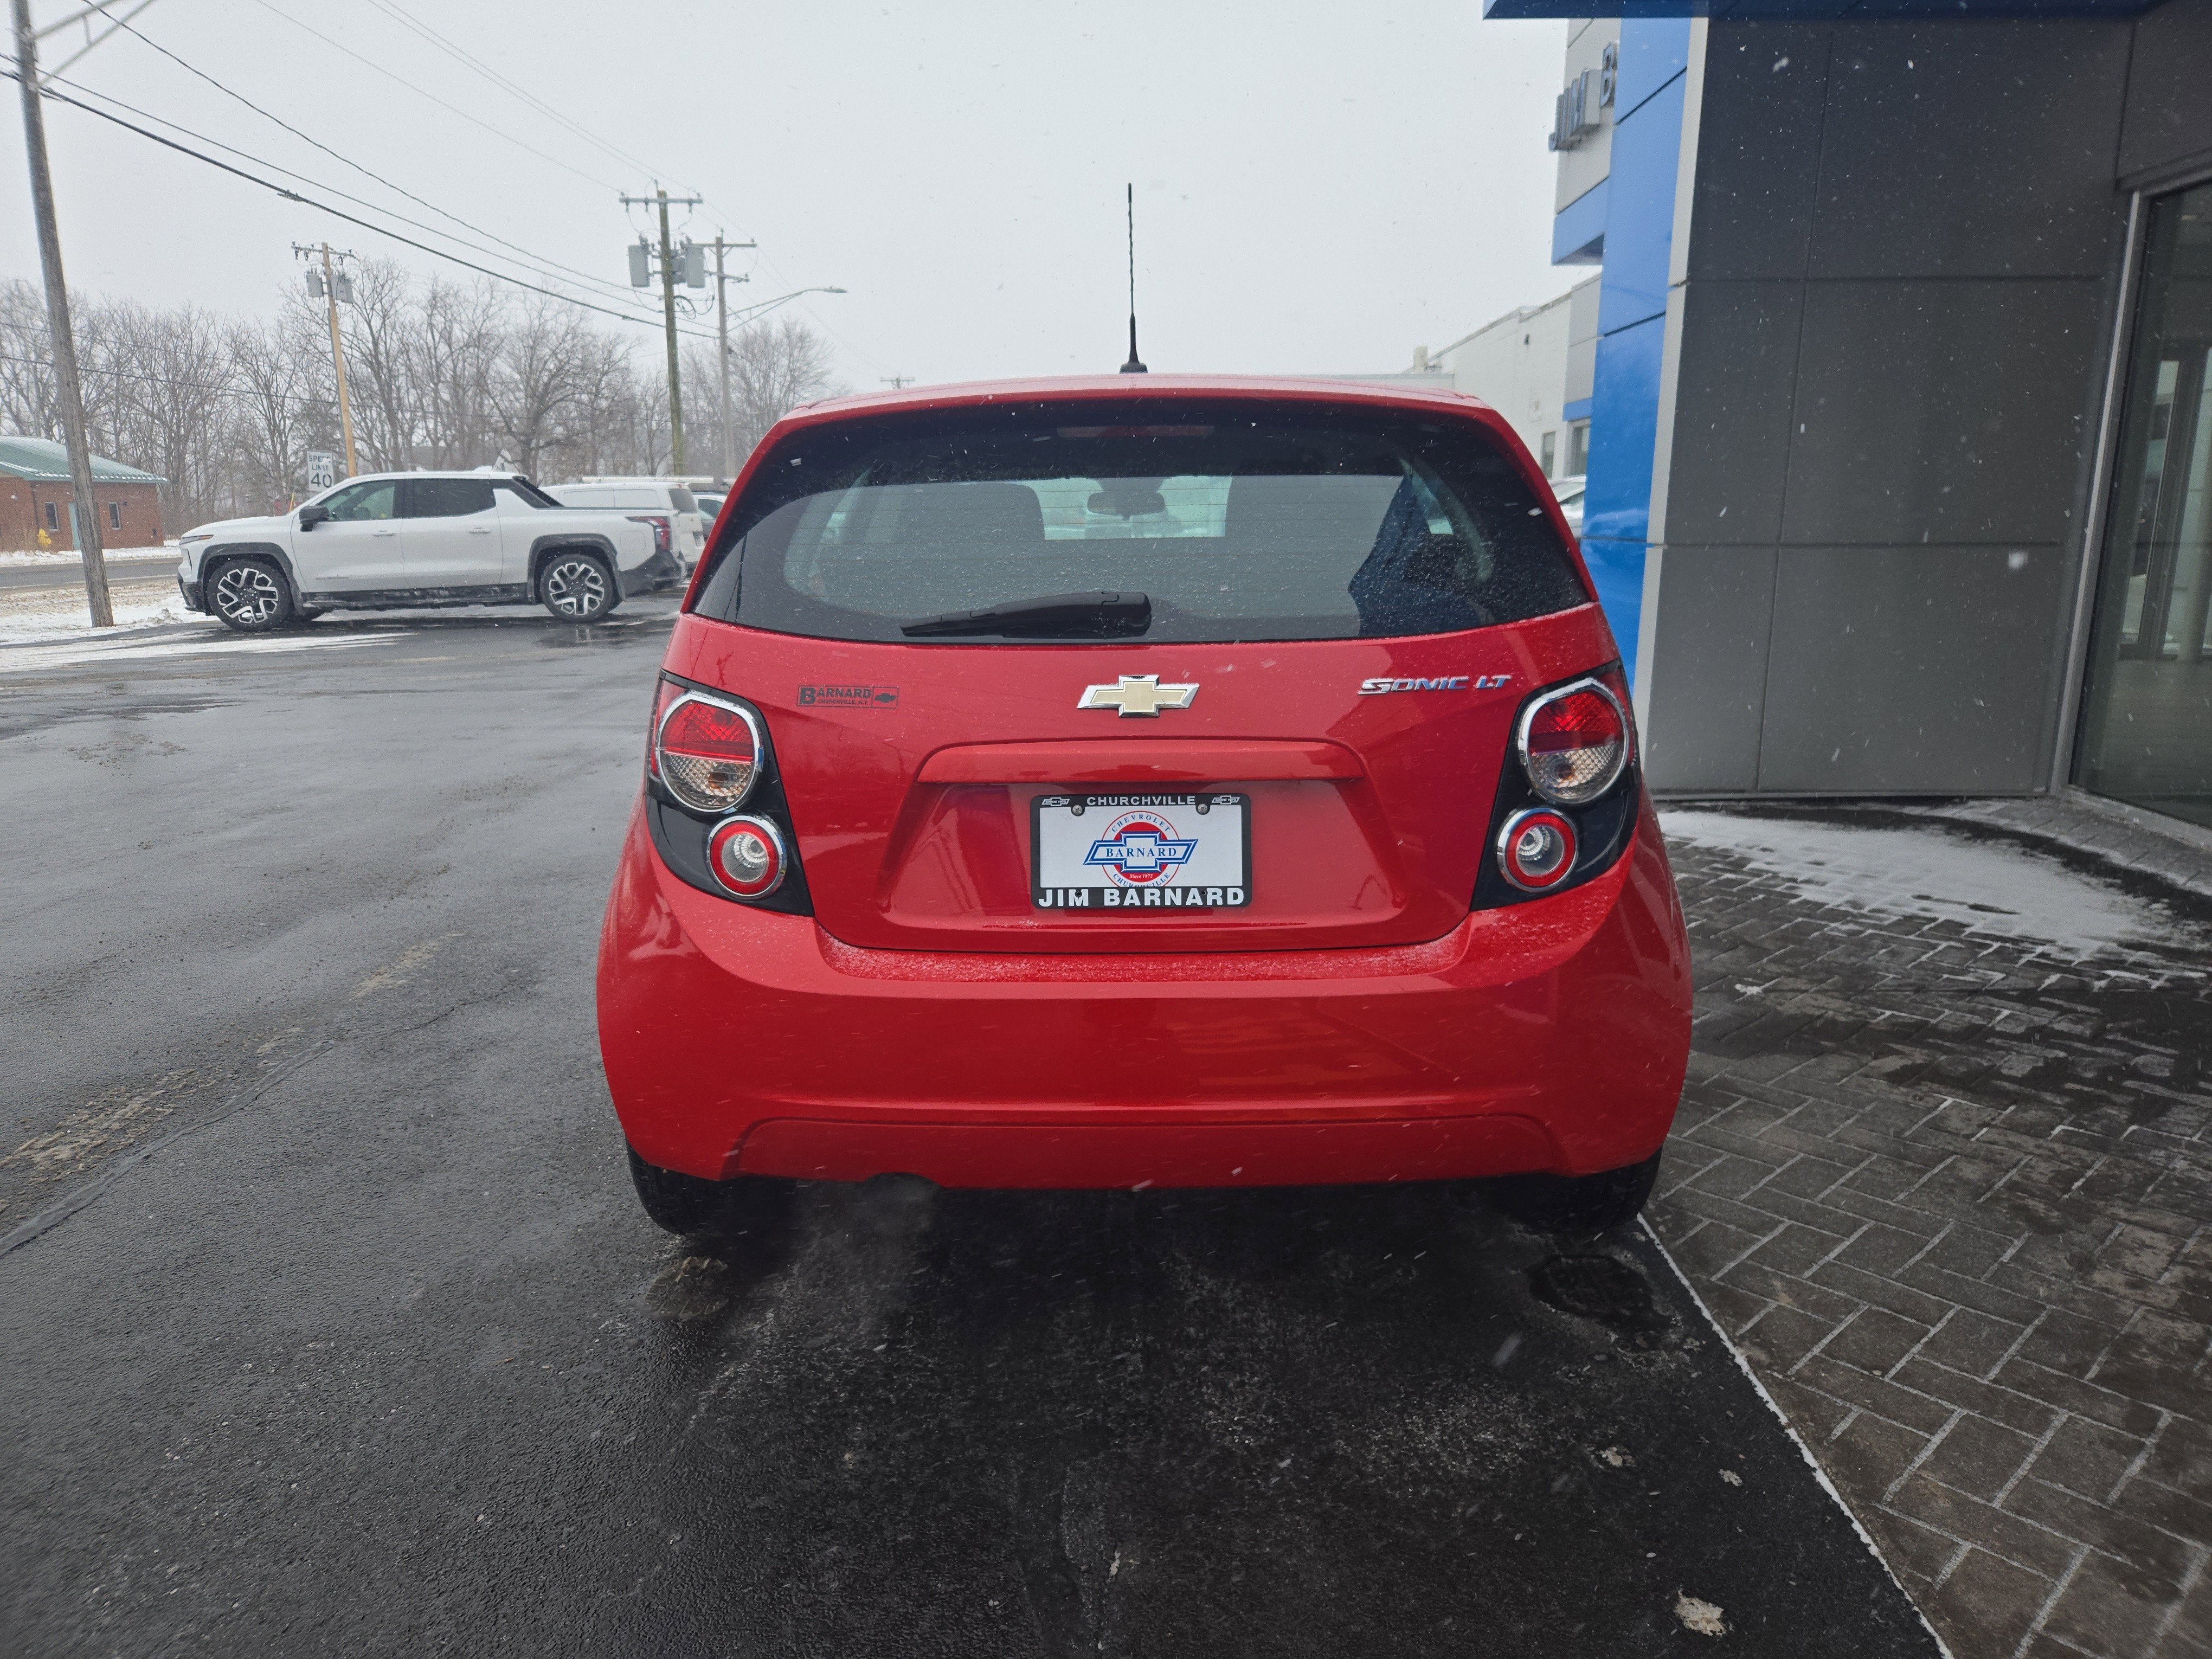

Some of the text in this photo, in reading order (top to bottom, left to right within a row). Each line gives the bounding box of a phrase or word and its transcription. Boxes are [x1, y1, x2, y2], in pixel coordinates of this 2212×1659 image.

[311, 473, 332, 488] 40
[1358, 674, 1512, 695] SONIC LT
[800, 687, 871, 705] BARNARD
[1086, 795, 1196, 806] CHURCHVILLE
[1111, 814, 1171, 832] CHEVROLET
[1105, 847, 1177, 857] BARNARD
[1038, 888, 1244, 907] JIM BARNARD
